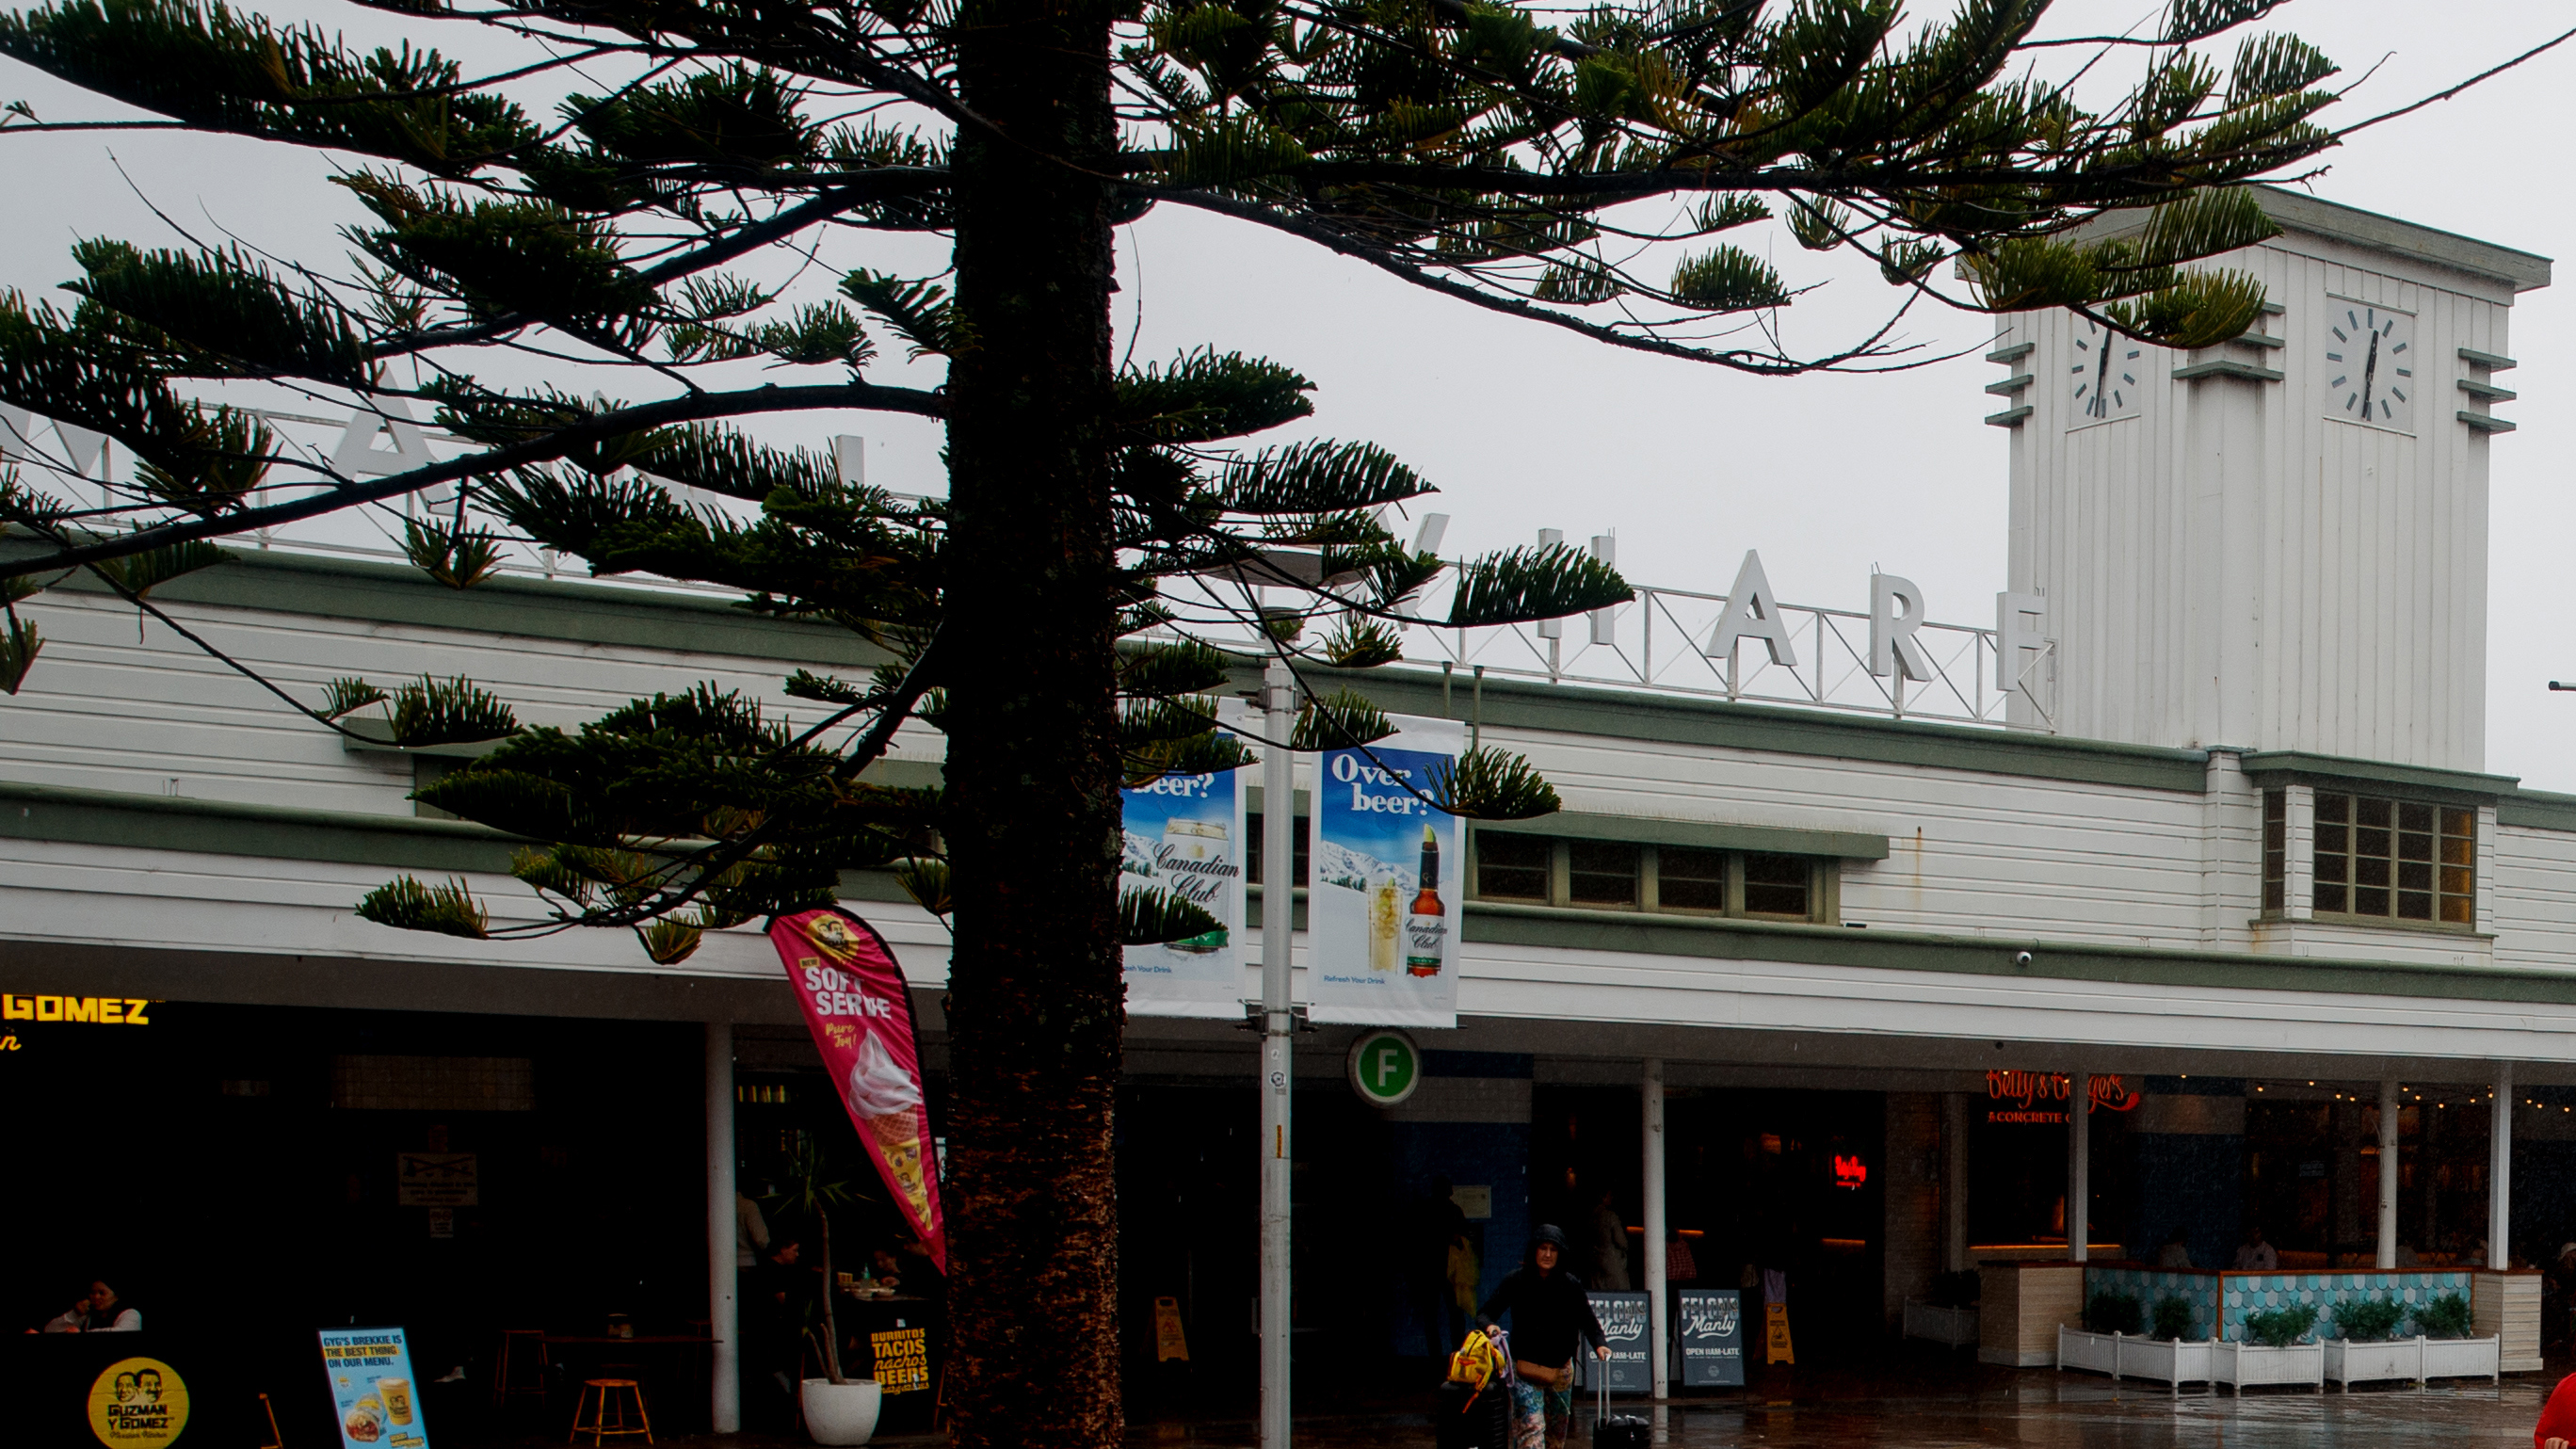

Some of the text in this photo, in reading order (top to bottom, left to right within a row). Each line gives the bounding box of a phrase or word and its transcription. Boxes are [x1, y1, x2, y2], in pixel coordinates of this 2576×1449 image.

[1332, 753, 1412, 788] Over
[1351, 782, 1435, 816] beer?
[1153, 844, 1240, 877] Canadian
[1171, 874, 1222, 903] Club
[1405, 917, 1448, 936] Canadian
[1412, 933, 1438, 949] Club
[805, 967, 864, 993] SOFT
[3, 994, 150, 1025] GOMEZ
[815, 991, 893, 1020] SERVE
[825, 1022, 856, 1037] Pure
[1377, 1049, 1398, 1087] F
[1996, 1111, 2063, 1124] CONCRETE
[1680, 1297, 1739, 1320] FELONS
[871, 1328, 926, 1343] BURRITOS
[1682, 1313, 1737, 1339] Manly
[324, 1335, 402, 1346] GYG'S BREKKIE IS
[872, 1338, 926, 1359] TACOS
[326, 1345, 397, 1358] THE BEST THING
[1685, 1347, 1705, 1357] OPEN
[328, 1358, 394, 1368] ON OUR MENU.
[874, 1354, 927, 1370] nachos
[875, 1366, 929, 1385] BEERS
[108, 1405, 168, 1417] GUZMAN
[108, 1418, 168, 1430] Y GOMEZ
